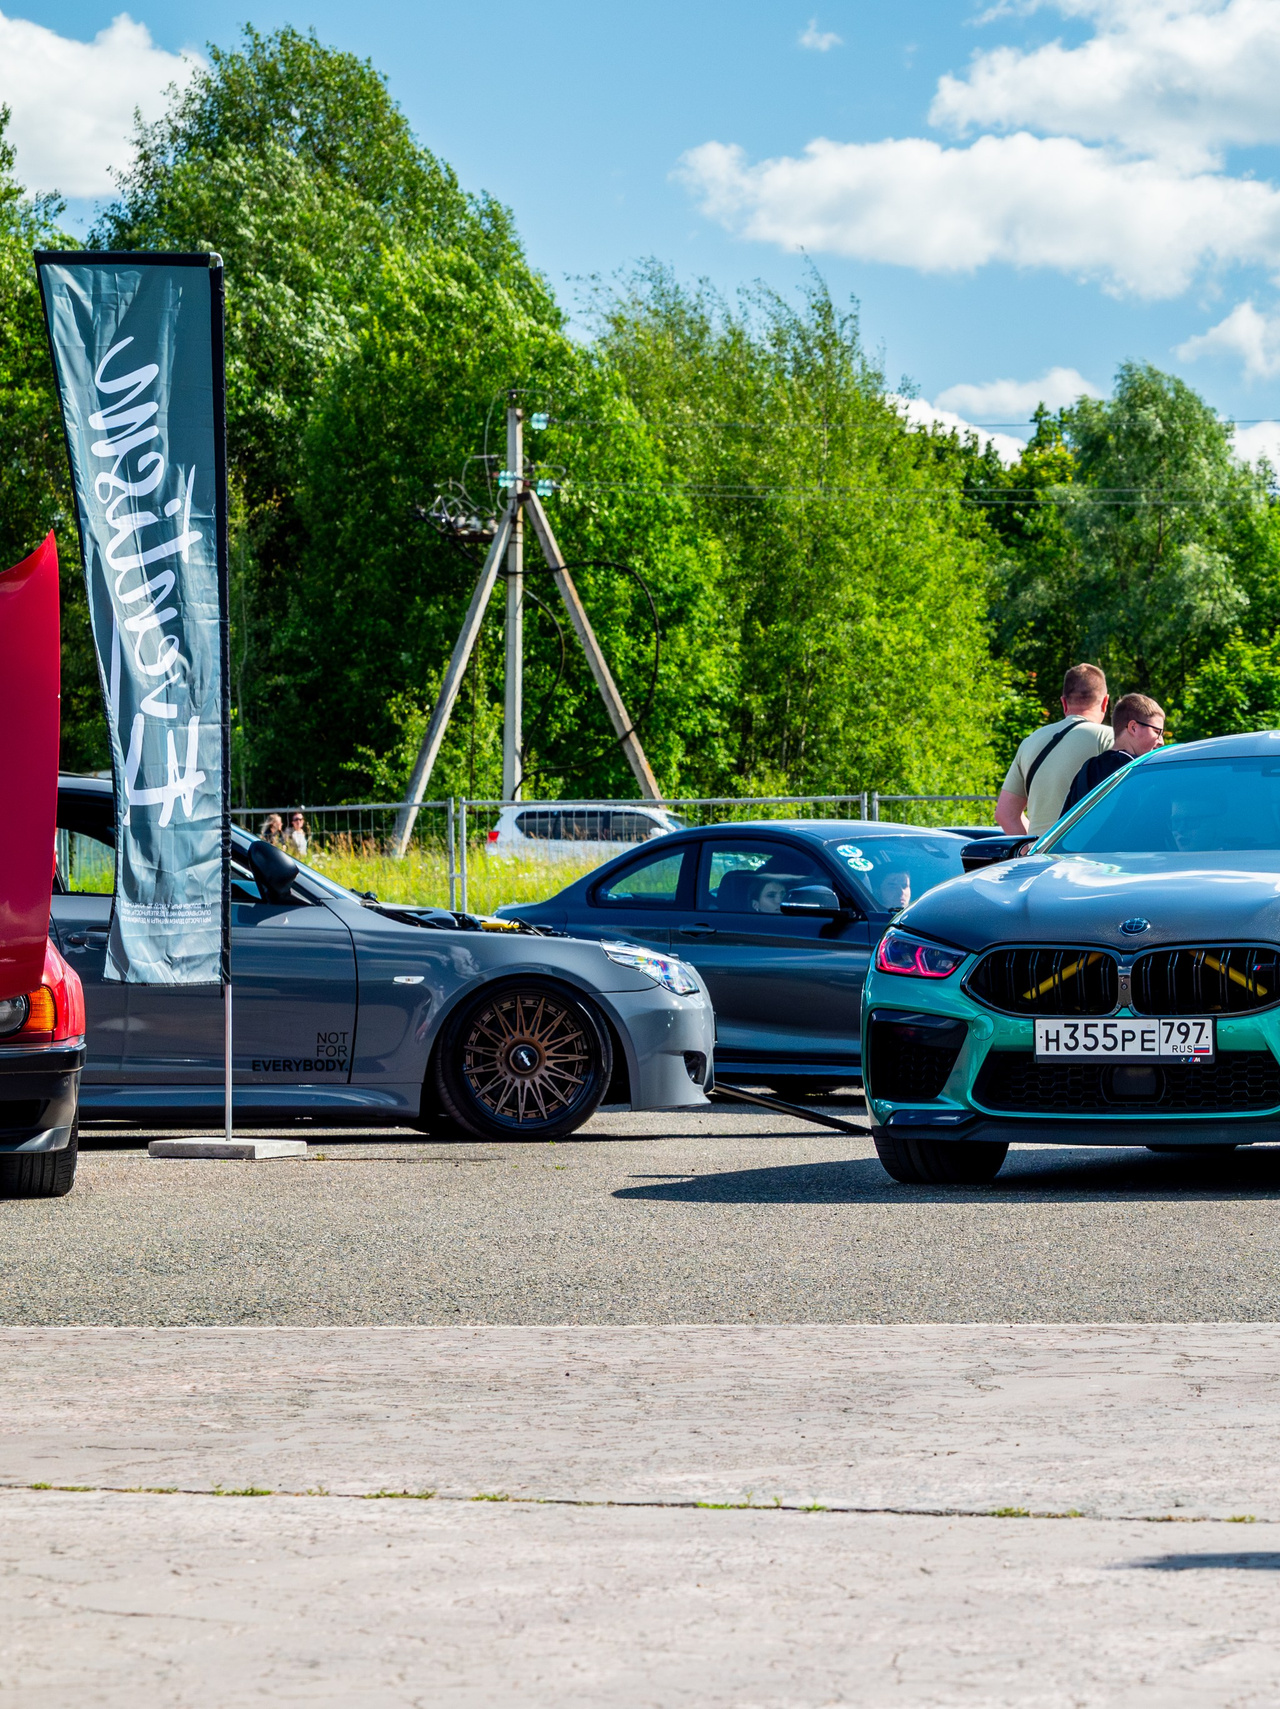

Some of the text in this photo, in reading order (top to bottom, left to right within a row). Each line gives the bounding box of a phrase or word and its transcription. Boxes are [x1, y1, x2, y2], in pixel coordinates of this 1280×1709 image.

[317, 1032, 349, 1044] NOT
[1162, 1022, 1206, 1044] 797
[316, 1045, 348, 1057] FOR
[1172, 1045, 1193, 1053] RUS
[252, 1060, 349, 1072] EVERYBODY.
